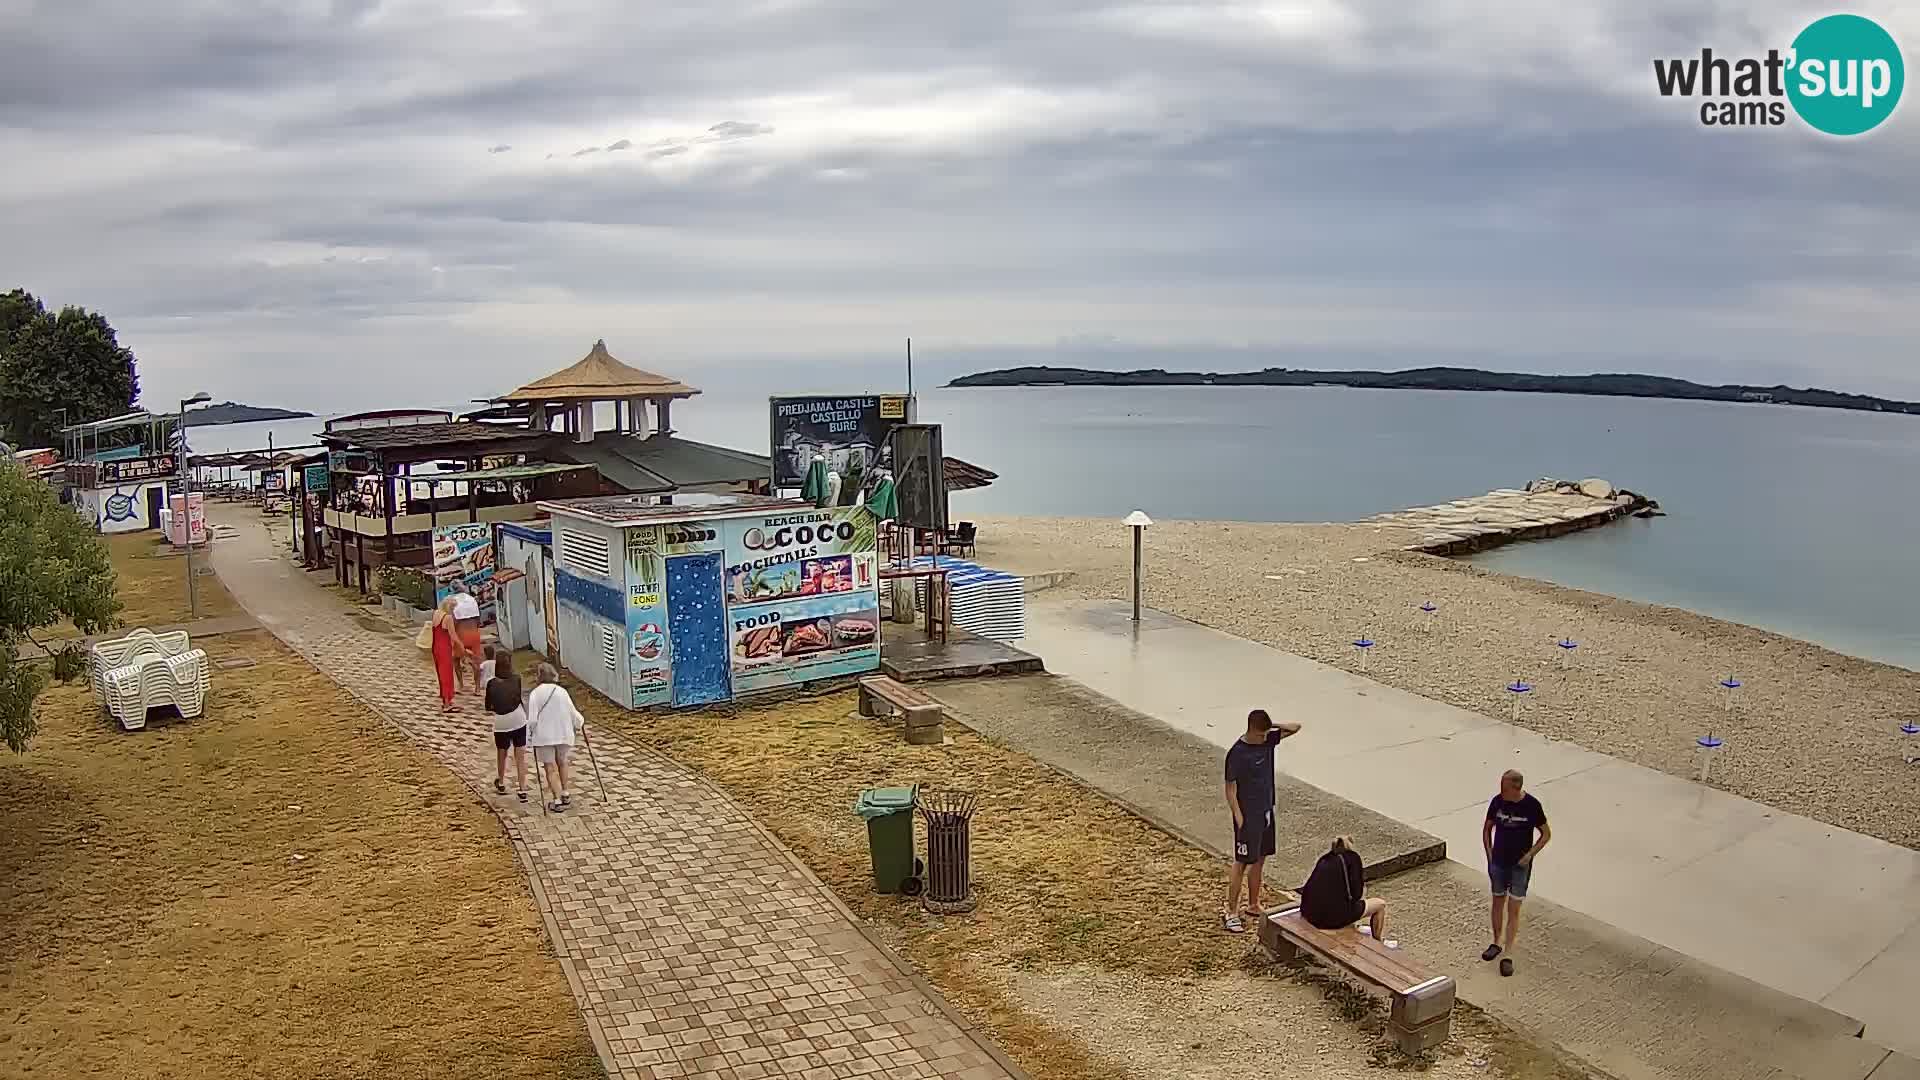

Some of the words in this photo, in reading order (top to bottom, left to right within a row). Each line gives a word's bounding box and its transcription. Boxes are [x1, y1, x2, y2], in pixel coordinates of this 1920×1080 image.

[778, 401, 834, 417] PREDJAMA
[835, 397, 875, 410] CASTLE
[810, 409, 862, 424] CASTELLO
[829, 420, 858, 433] BURG
[765, 515, 805, 528] BEACH
[806, 513, 833, 524] BAR
[451, 527, 487, 541] COCO
[774, 521, 855, 547] COCO
[731, 545, 818, 576] COCKTAILS
[735, 611, 781, 632] FOOD
